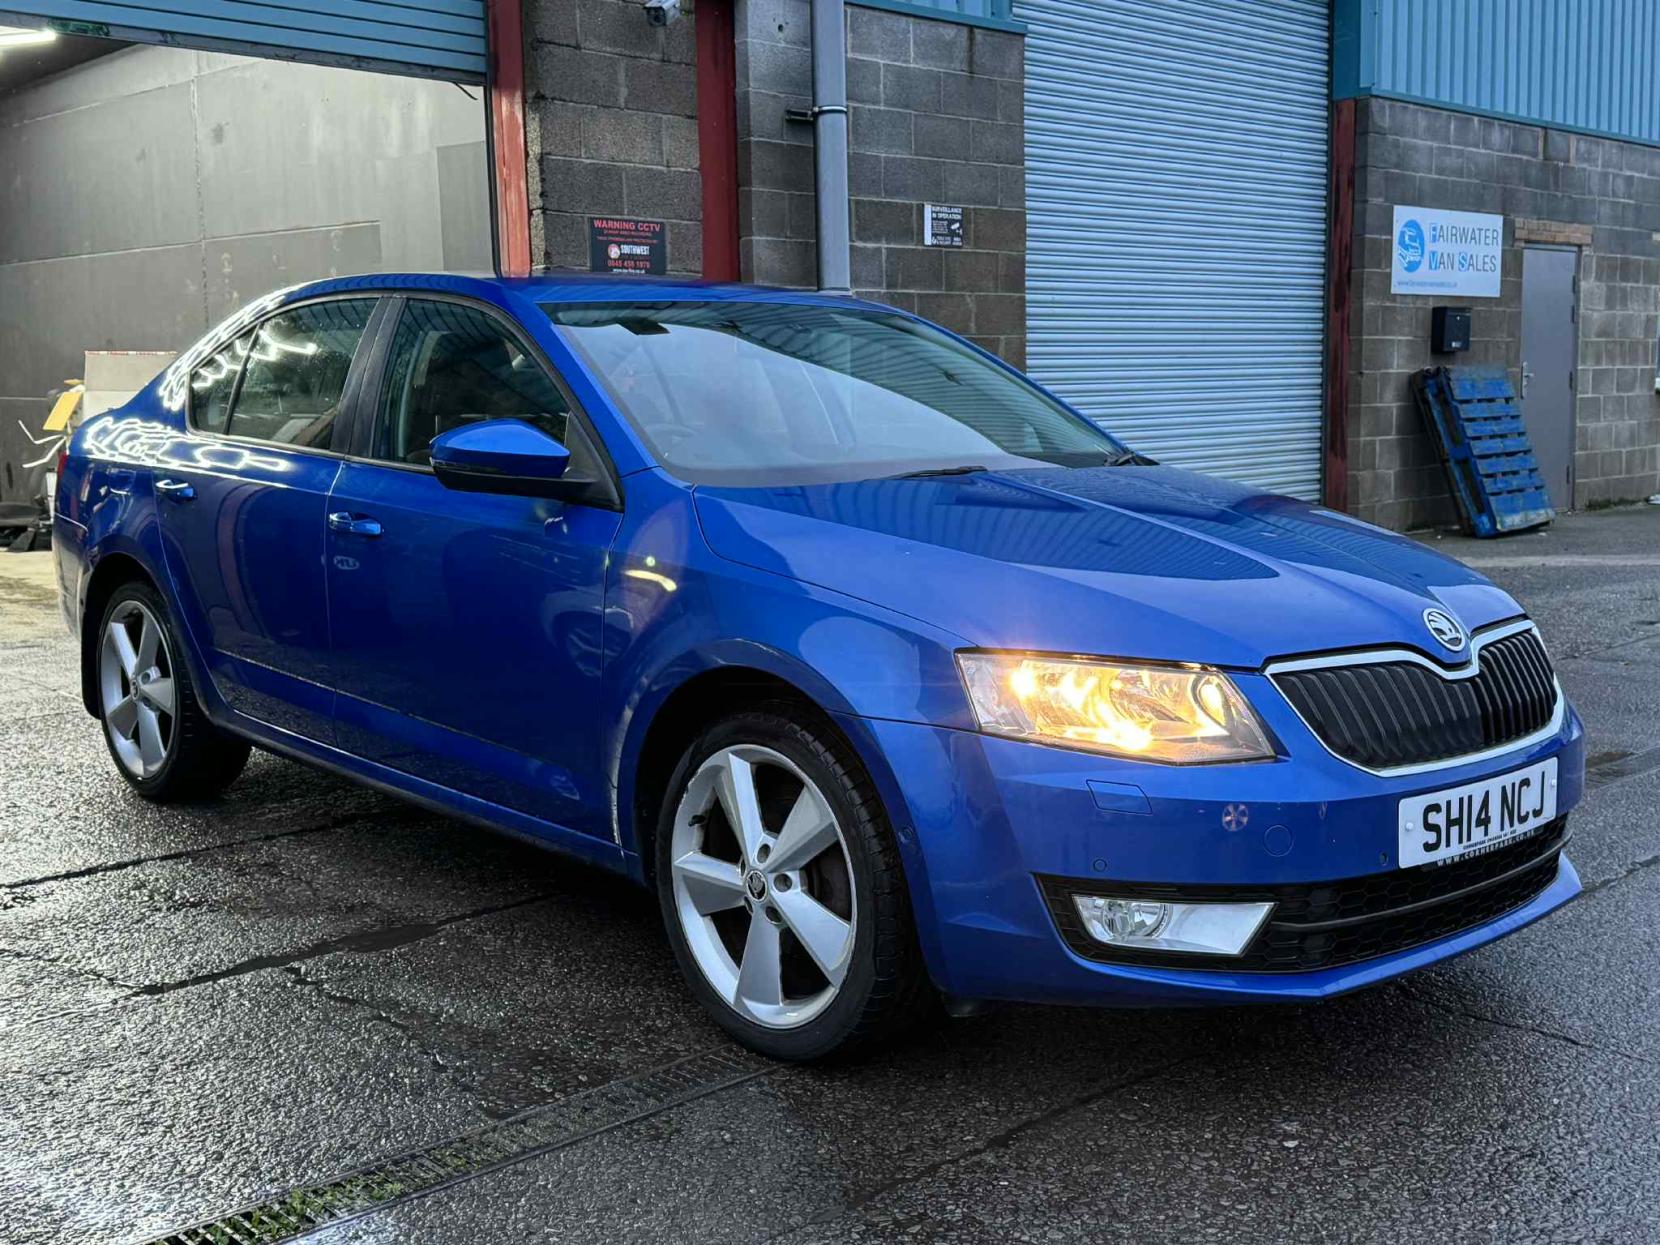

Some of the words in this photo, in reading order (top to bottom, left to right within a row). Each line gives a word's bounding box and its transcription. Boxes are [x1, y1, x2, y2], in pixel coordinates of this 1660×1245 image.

[593, 219, 635, 230] WARNING
[638, 222, 660, 232] CCTV
[1430, 223, 1499, 246] FAIRWATER
[620, 244, 650, 255] SOUTHWEST
[1429, 251, 1455, 271] VAN
[1458, 252, 1497, 273] SALES
[1422, 790, 1492, 853] SH14
[1500, 771, 1546, 832] NCJ
[1436, 829, 1536, 867] WWW.CORNERPARK.CO.UK
